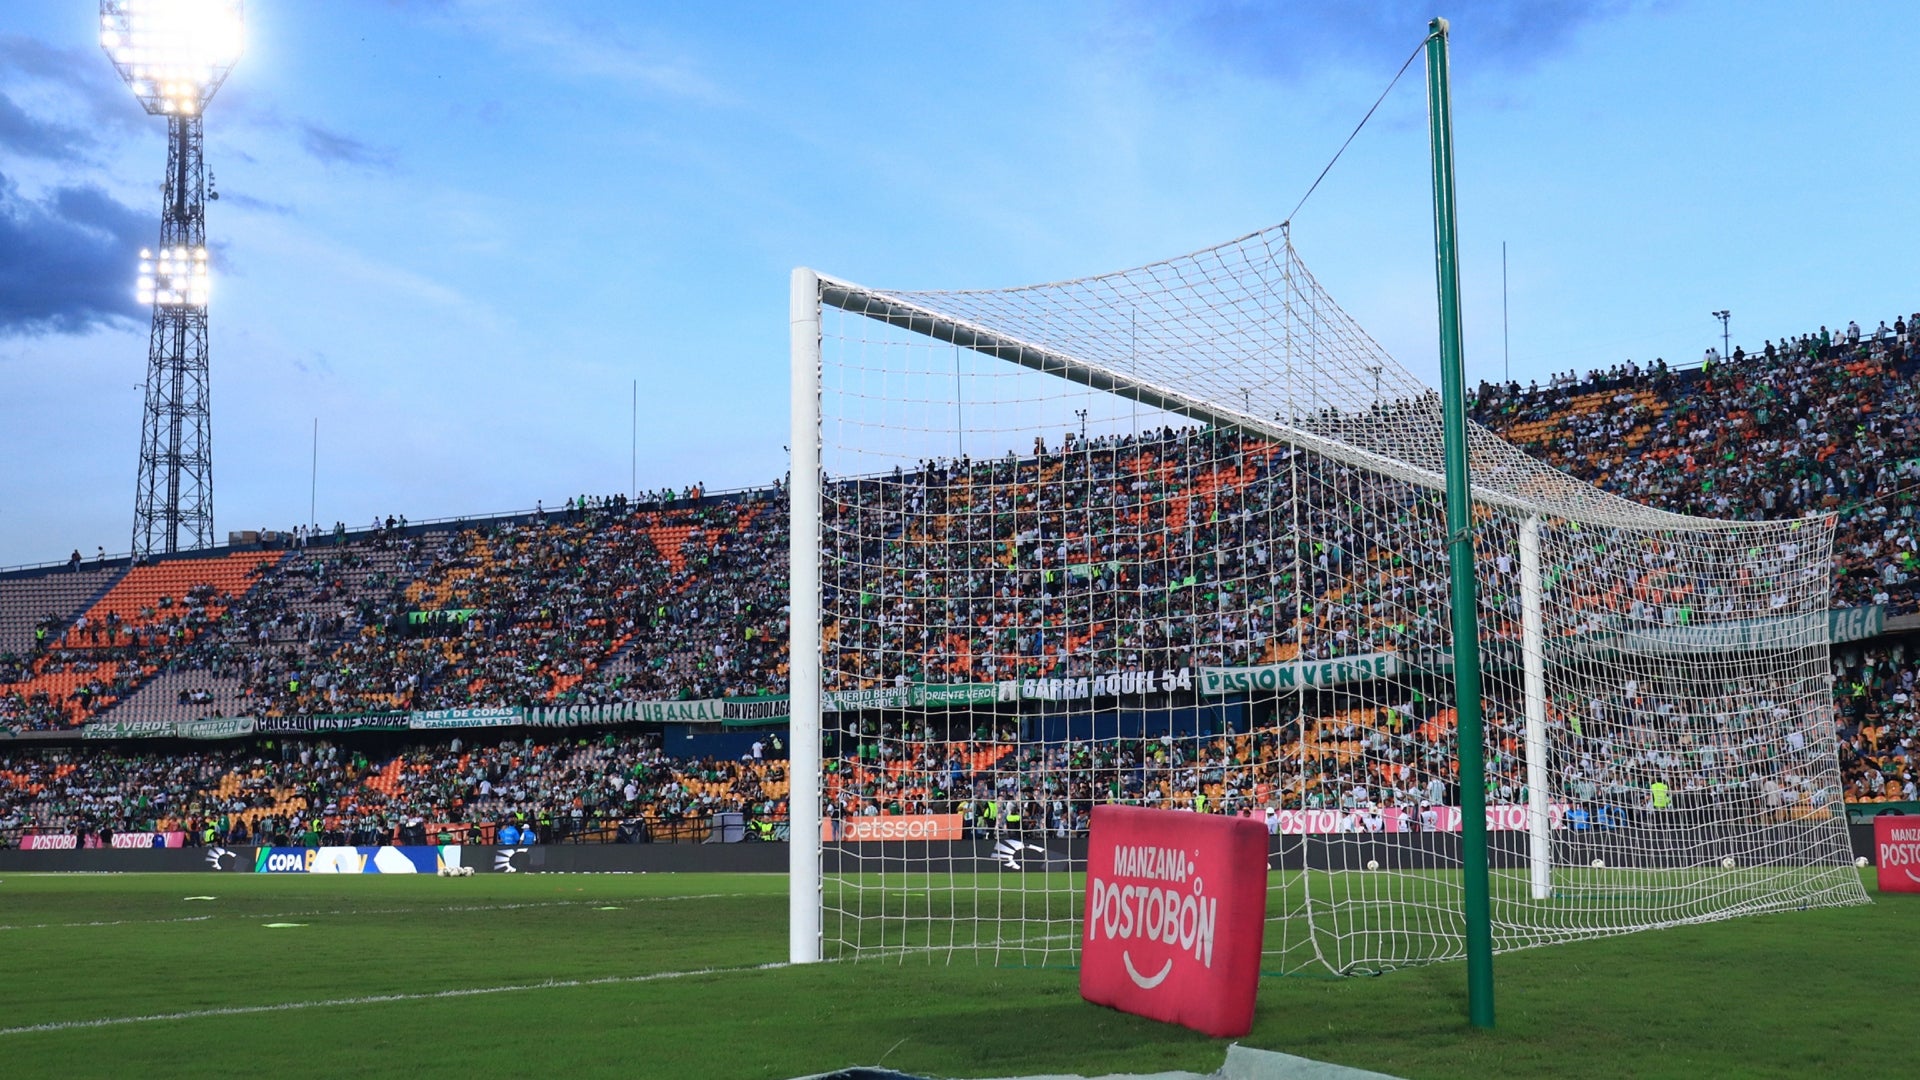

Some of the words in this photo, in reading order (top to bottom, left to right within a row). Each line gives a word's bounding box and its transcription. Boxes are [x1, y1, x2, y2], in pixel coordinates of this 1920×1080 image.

[1207, 665, 1295, 690] PASION
[1303, 654, 1389, 684] VERDE
[1022, 676, 1089, 700] BARRA
[1093, 670, 1157, 696] AQUEL
[1162, 667, 1192, 691] 54
[834, 690, 871, 701] PUERTO
[925, 690, 964, 701] ORIENTE
[966, 688, 997, 700] VERDE
[426, 711, 450, 719] REY
[453, 709, 469, 718] DE
[472, 707, 514, 717] COPAS
[723, 702, 740, 718] ADN
[91, 723, 118, 732] PAZ
[123, 721, 171, 731] VERDE
[360, 712, 409, 729] SIEMPRE
[485, 718, 497, 726] LA
[268, 854, 303, 871] COPA
[1114, 845, 1186, 883] MANZANA
